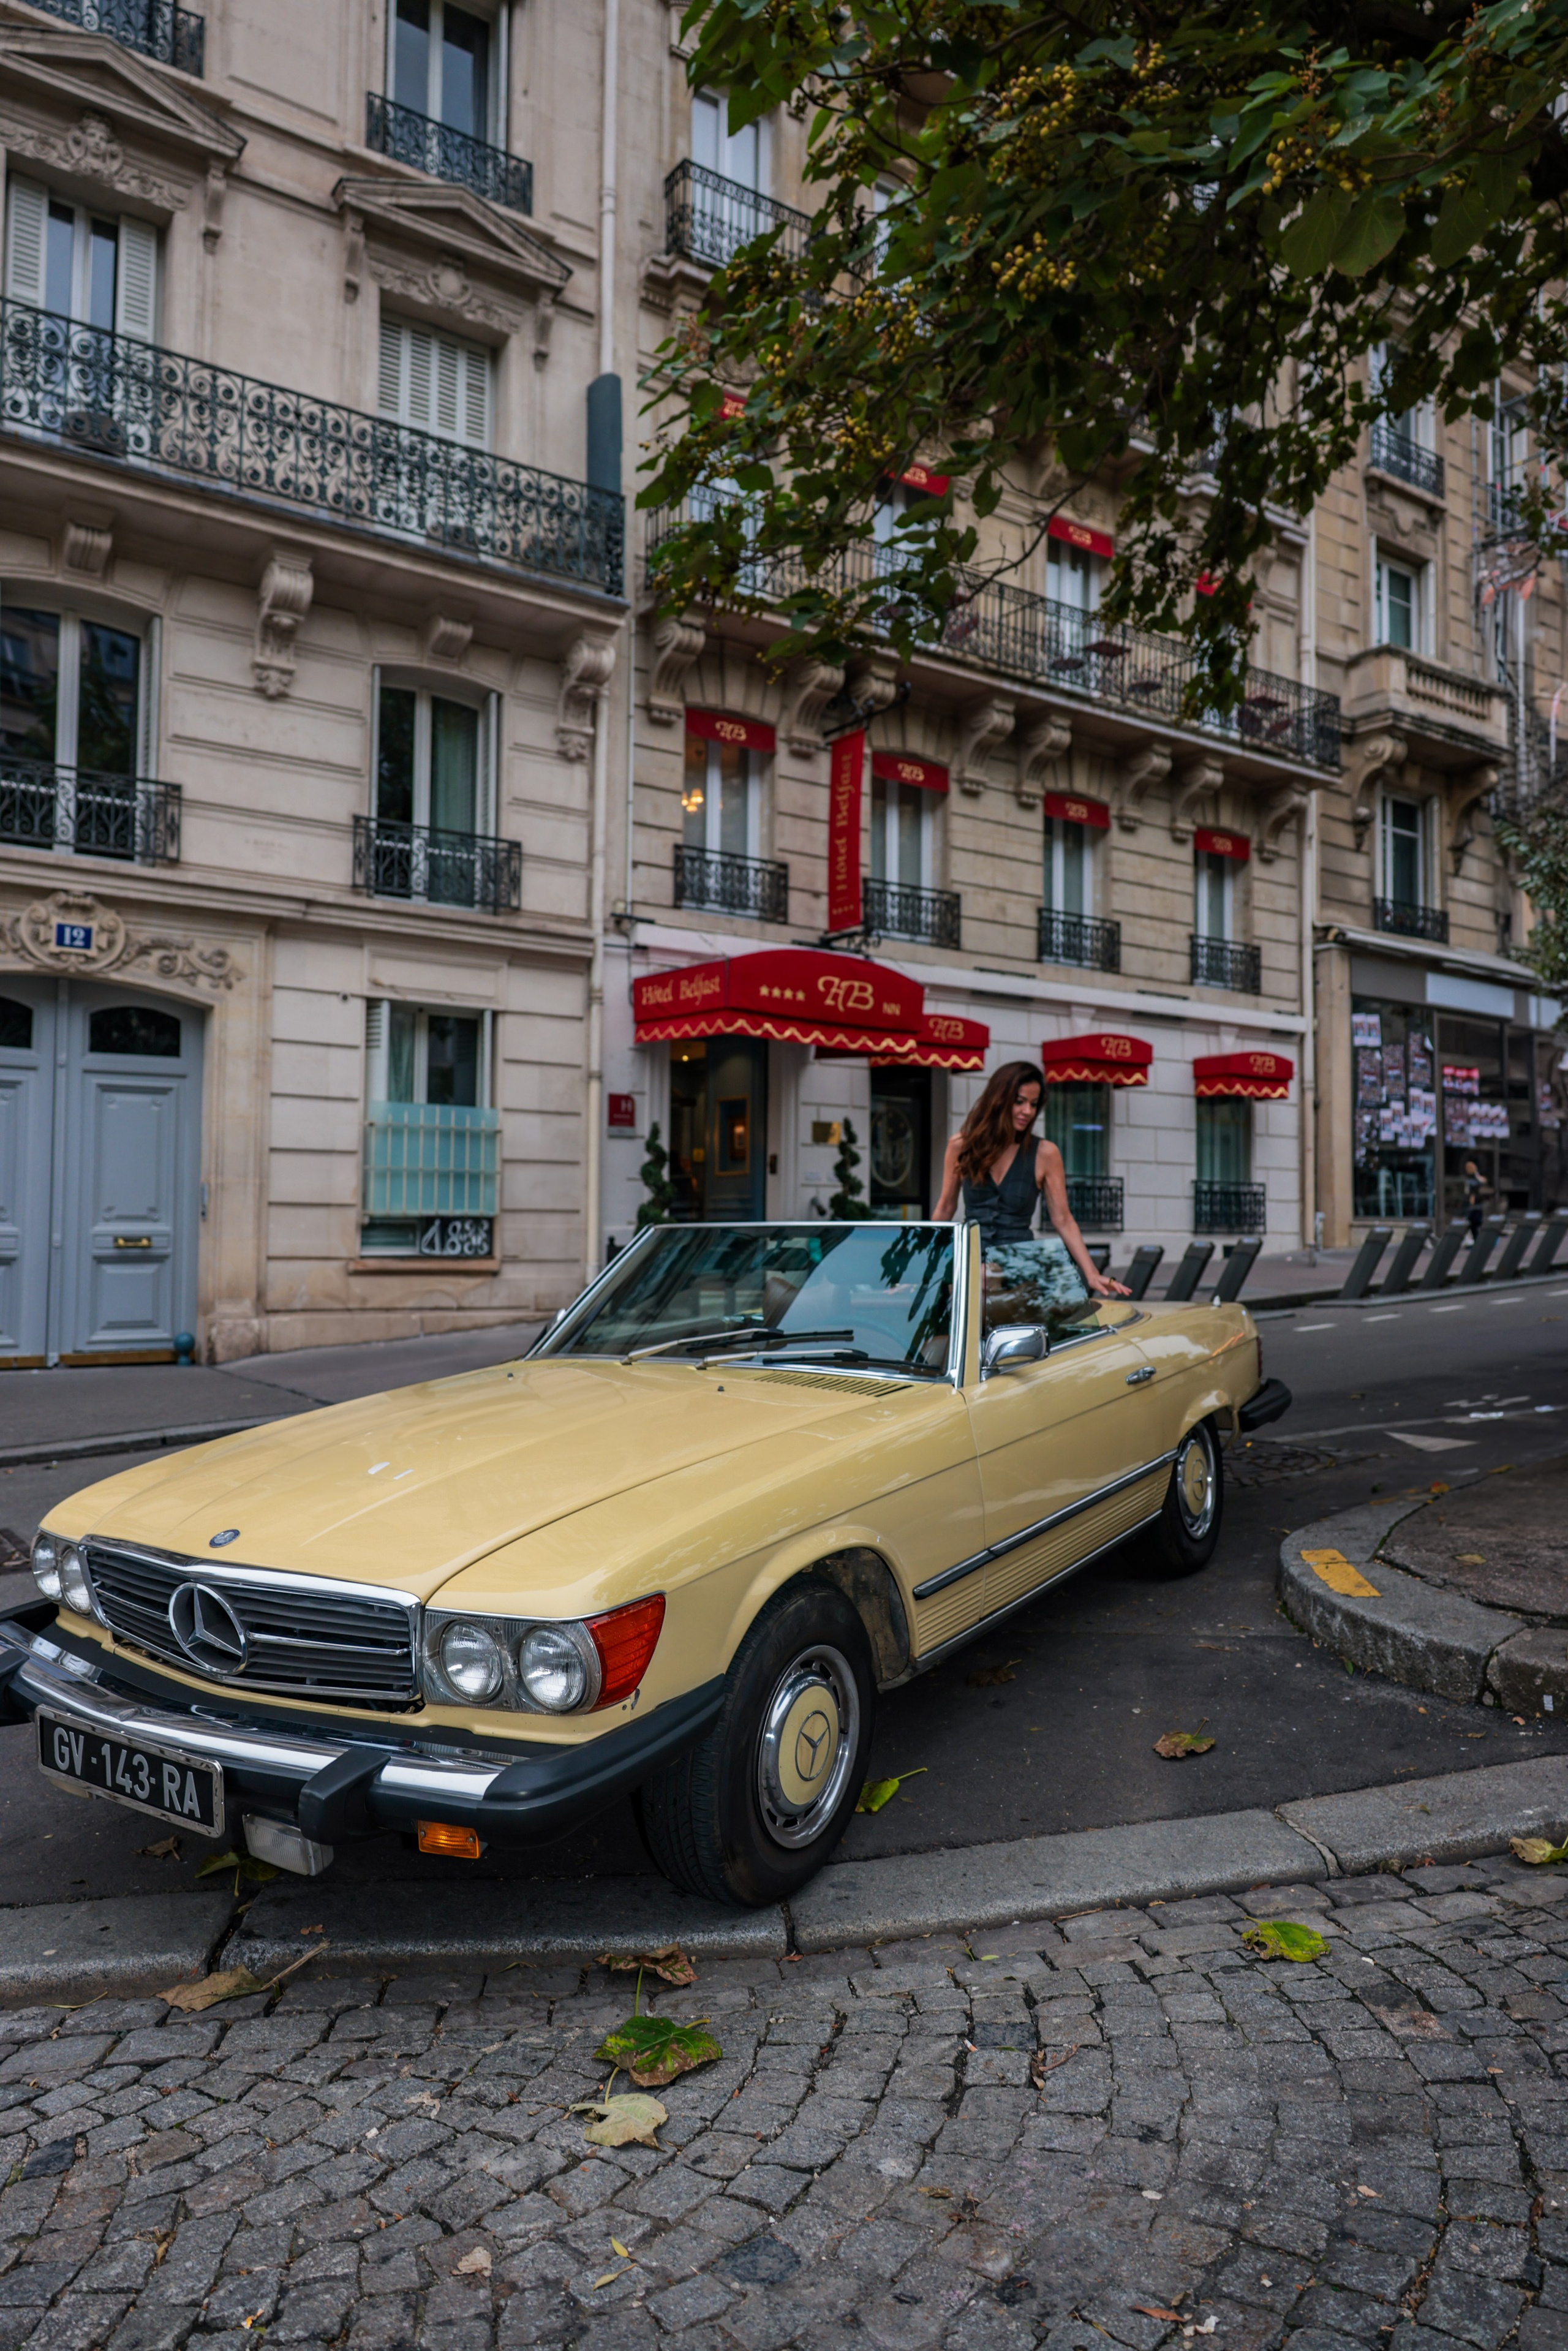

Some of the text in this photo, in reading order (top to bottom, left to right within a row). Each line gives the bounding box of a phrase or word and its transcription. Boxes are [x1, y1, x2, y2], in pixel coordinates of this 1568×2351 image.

[63, 926, 85, 946] 12
[679, 973, 720, 1005] Belfast
[818, 976, 875, 1012] HB
[929, 1017, 964, 1041] HB
[1101, 1036, 1132, 1059] HB
